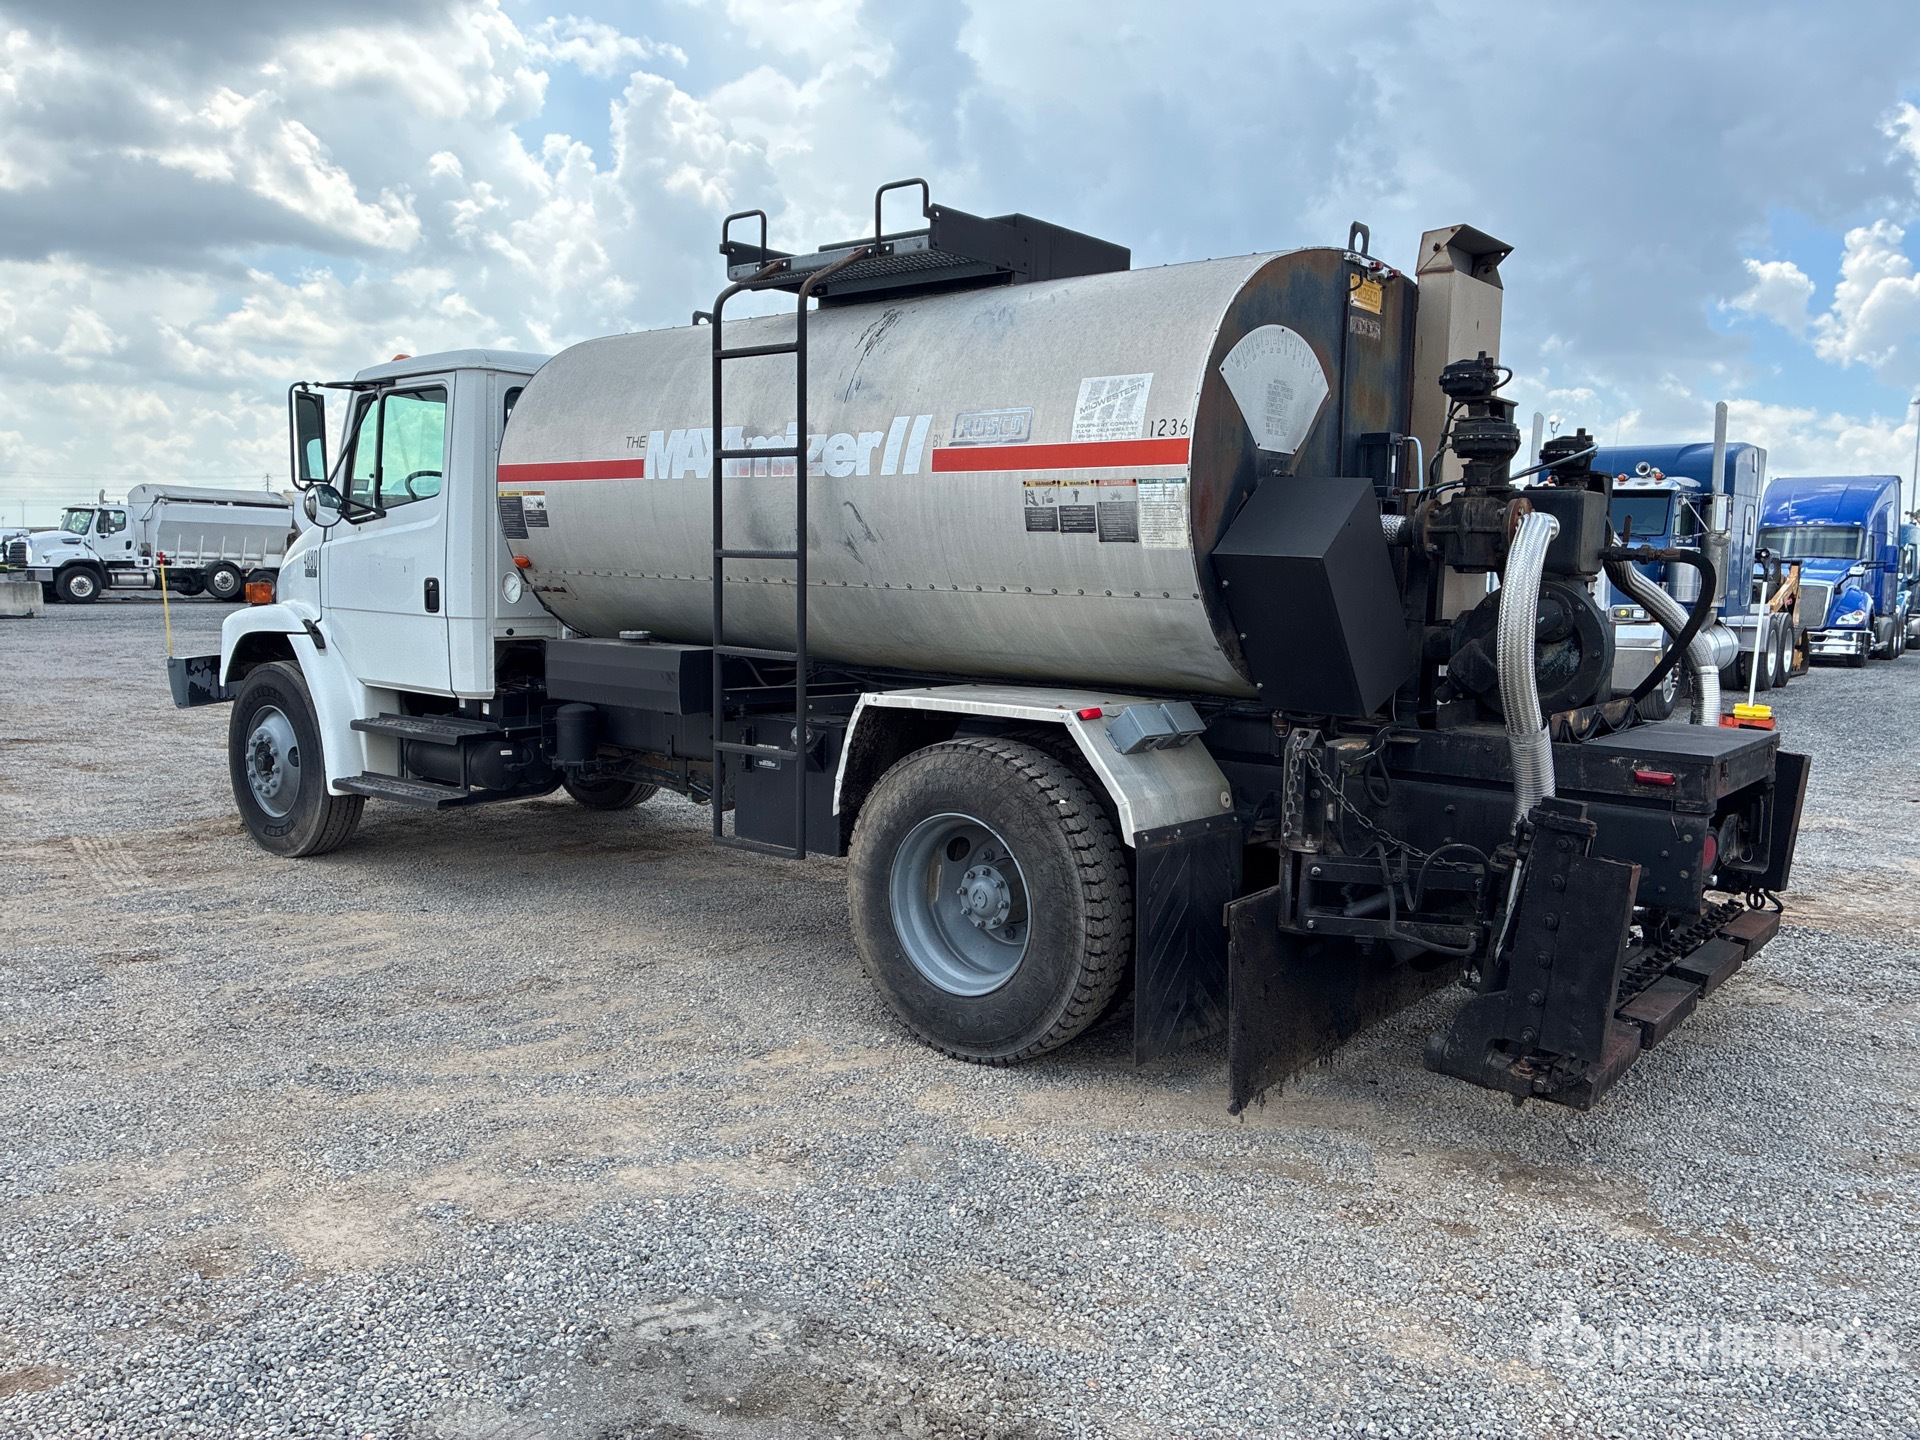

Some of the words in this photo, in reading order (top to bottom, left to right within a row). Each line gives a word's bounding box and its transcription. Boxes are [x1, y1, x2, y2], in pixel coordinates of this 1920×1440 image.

[1079, 381, 1146, 415] MIDWESTERN
[958, 414, 1026, 439] ROSCO
[1149, 417, 1189, 438] 1236
[625, 435, 647, 449] THE
[933, 434, 945, 448] BY
